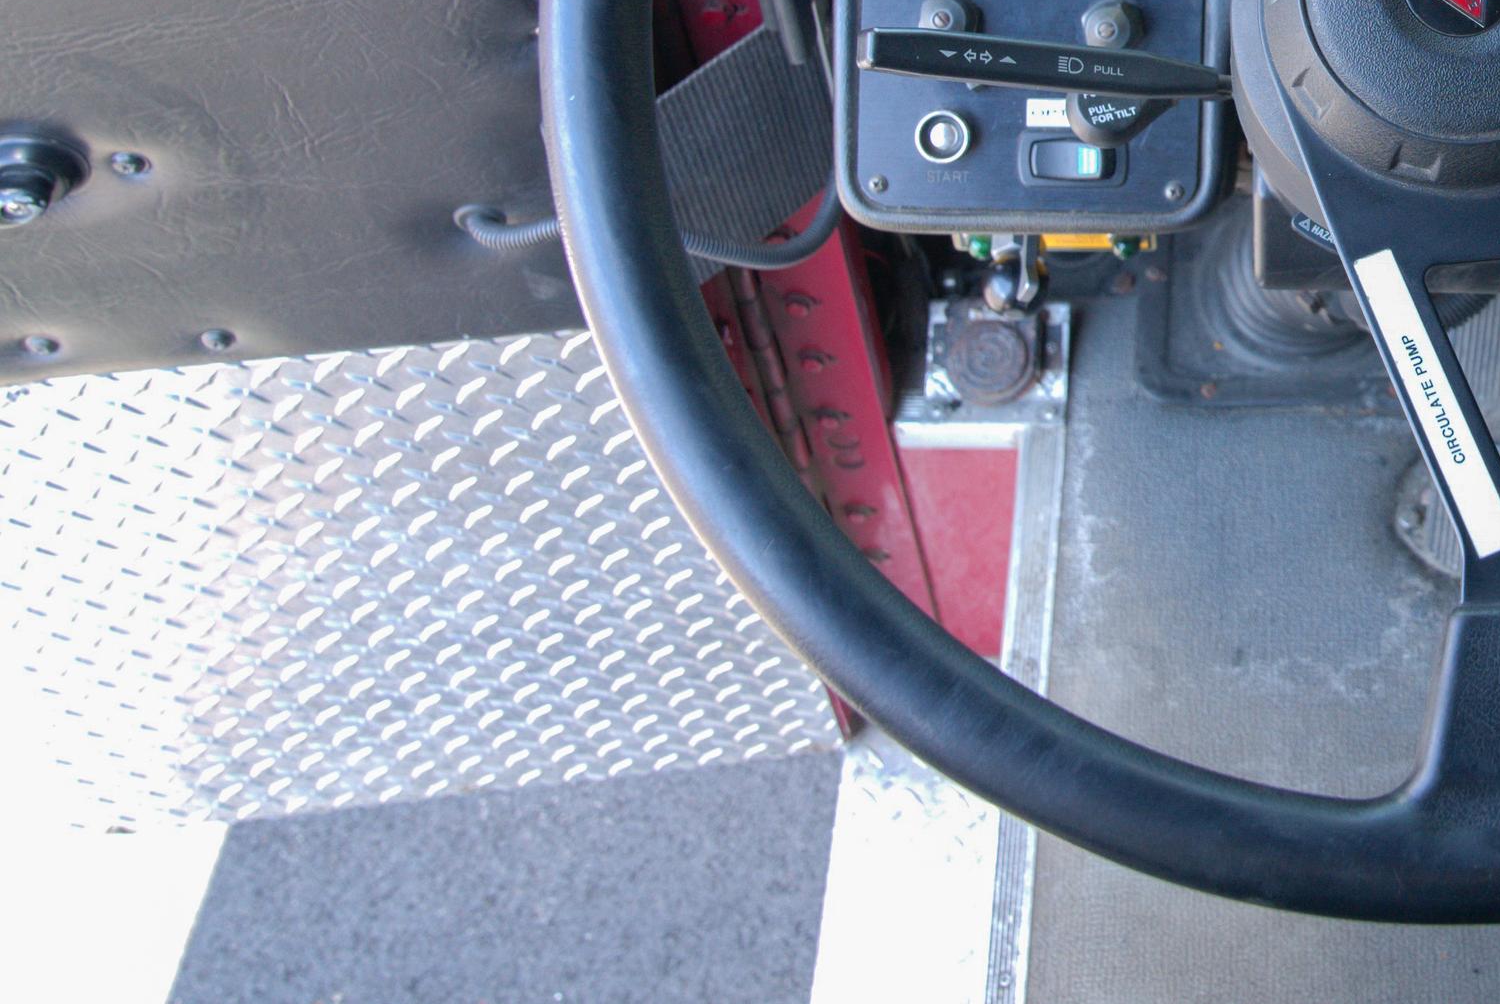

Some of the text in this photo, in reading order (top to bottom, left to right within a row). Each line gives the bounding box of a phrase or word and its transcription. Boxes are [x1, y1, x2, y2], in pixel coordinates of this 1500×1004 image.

[1094, 65, 1124, 76] PULL
[1088, 103, 1115, 116] PULL
[1091, 107, 1136, 124] FOR TILT
[927, 171, 970, 183] START
[1402, 335, 1466, 465] CIRCULATE PUMP
